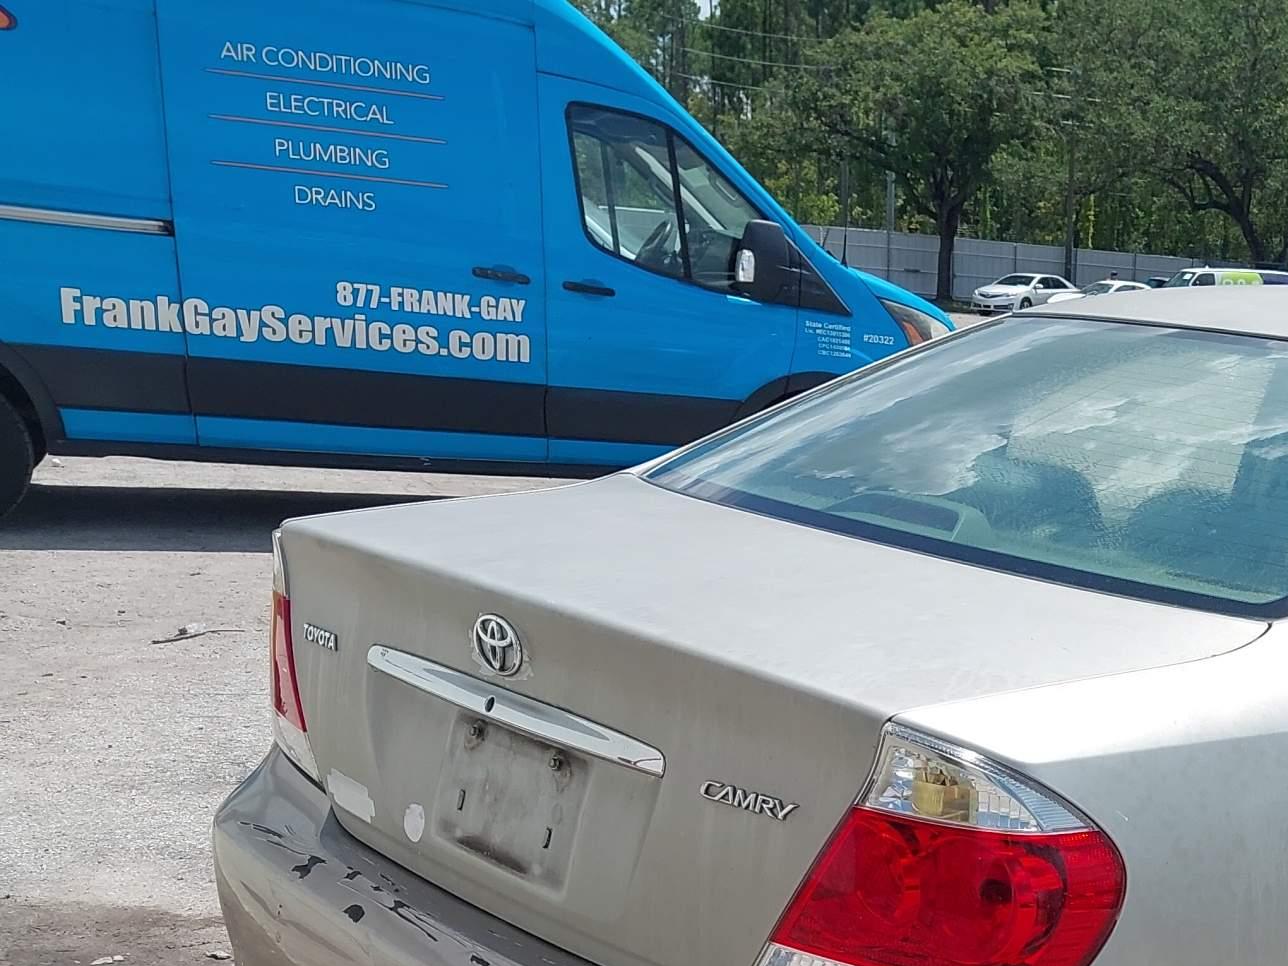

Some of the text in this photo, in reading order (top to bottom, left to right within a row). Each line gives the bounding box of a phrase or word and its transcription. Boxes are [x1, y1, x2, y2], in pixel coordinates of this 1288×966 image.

[220, 41, 430, 84] AIR CONDITIONING
[266, 92, 394, 124] ELECTRICAL
[275, 138, 389, 168] PLUMBING
[295, 185, 376, 211] DRAINS
[336, 281, 526, 322] 877-FRANK-GAY
[60, 287, 530, 363] FrankGayServices.com
[805, 320, 851, 331] State Certified
[863, 334, 895, 345] #20322
[303, 623, 337, 651] TOYOTA
[700, 780, 800, 820] CAMRY
